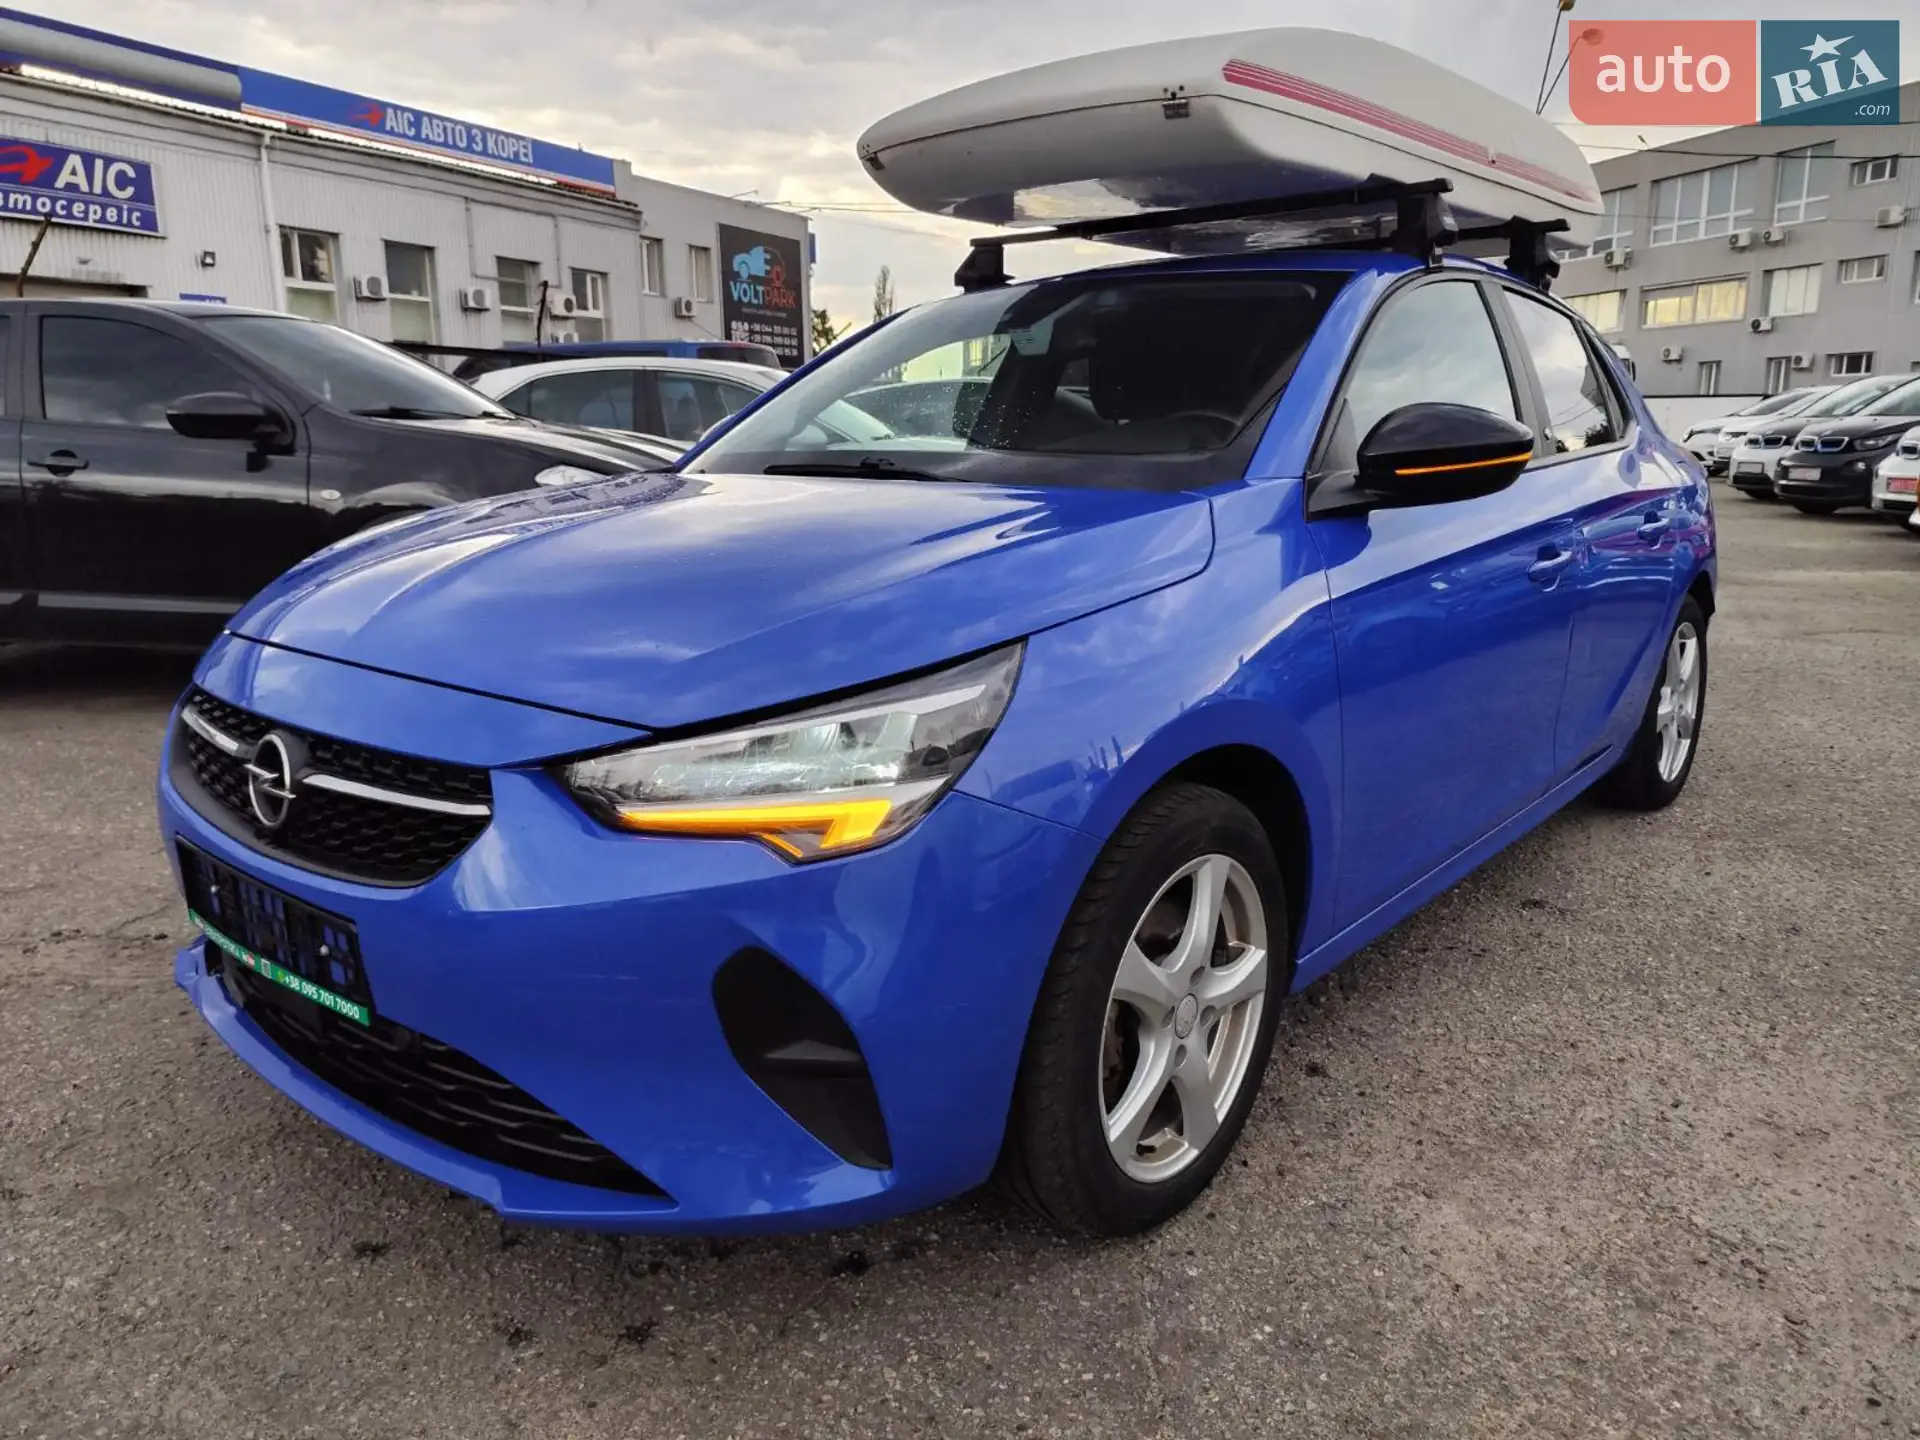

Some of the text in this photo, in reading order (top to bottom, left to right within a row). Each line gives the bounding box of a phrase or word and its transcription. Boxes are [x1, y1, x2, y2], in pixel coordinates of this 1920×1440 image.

[421, 116, 467, 149] АВТО
[319, 989, 335, 1009] 701
[335, 997, 360, 1019] 7000
